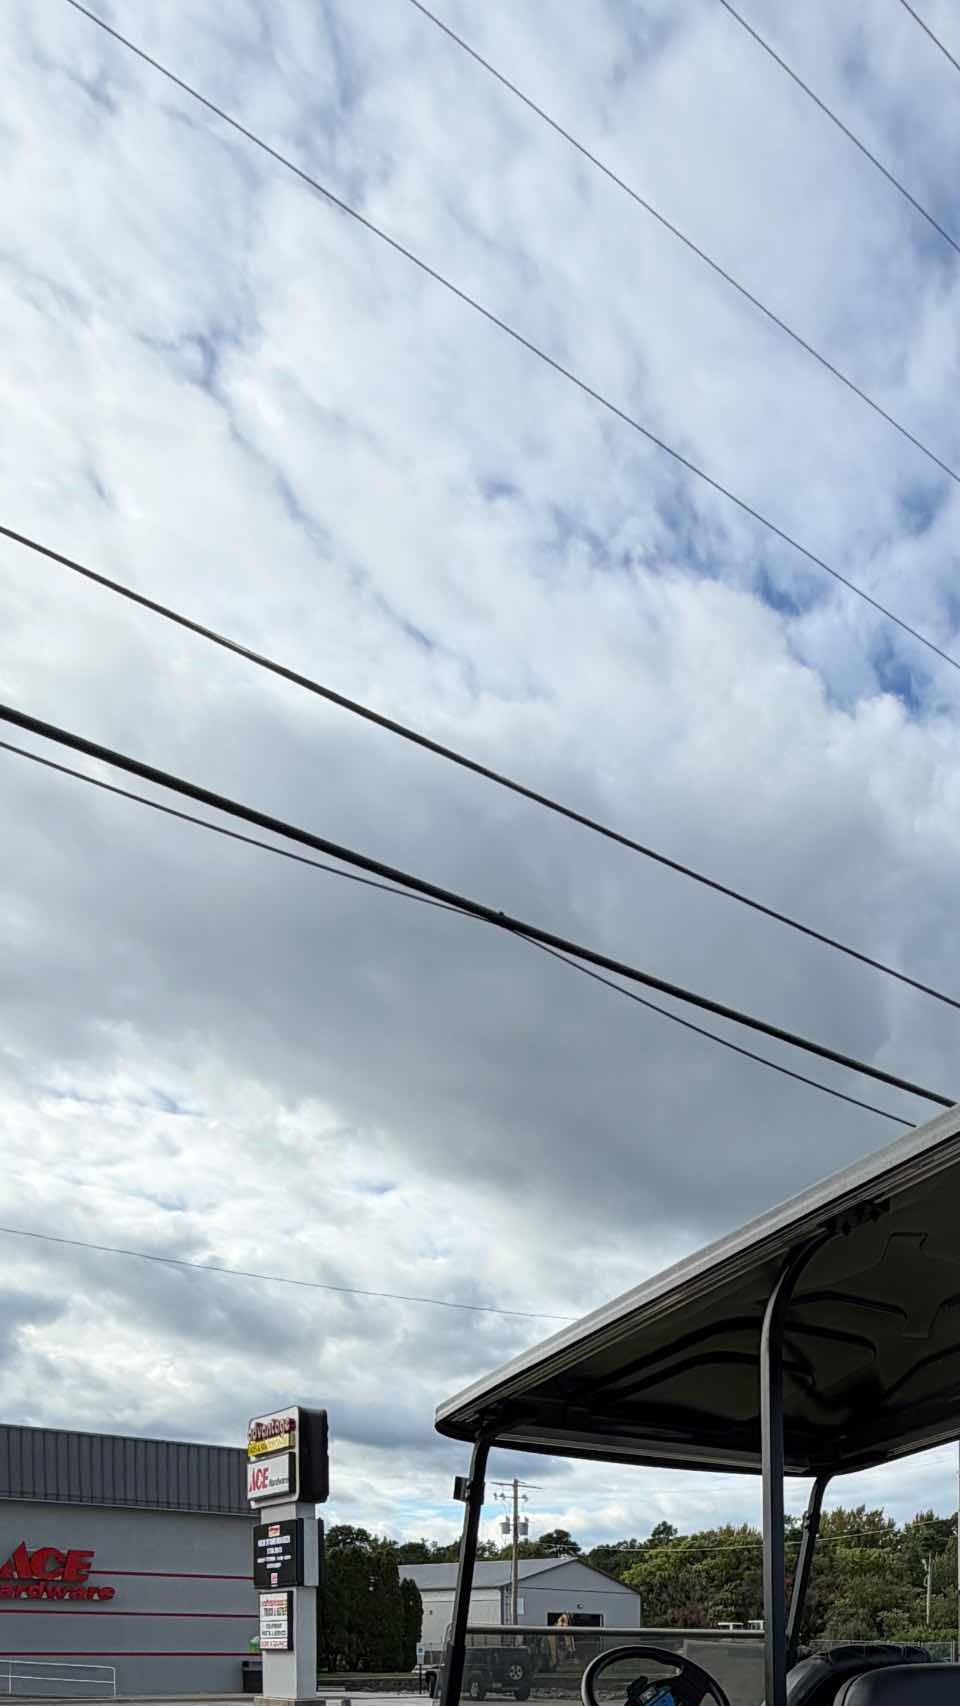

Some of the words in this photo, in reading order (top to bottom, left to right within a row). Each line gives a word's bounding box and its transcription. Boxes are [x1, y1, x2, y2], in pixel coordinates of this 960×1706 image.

[249, 1467, 270, 1492] ACE
[0, 1541, 95, 1582] ACE
[0, 1583, 116, 1601] ardware
